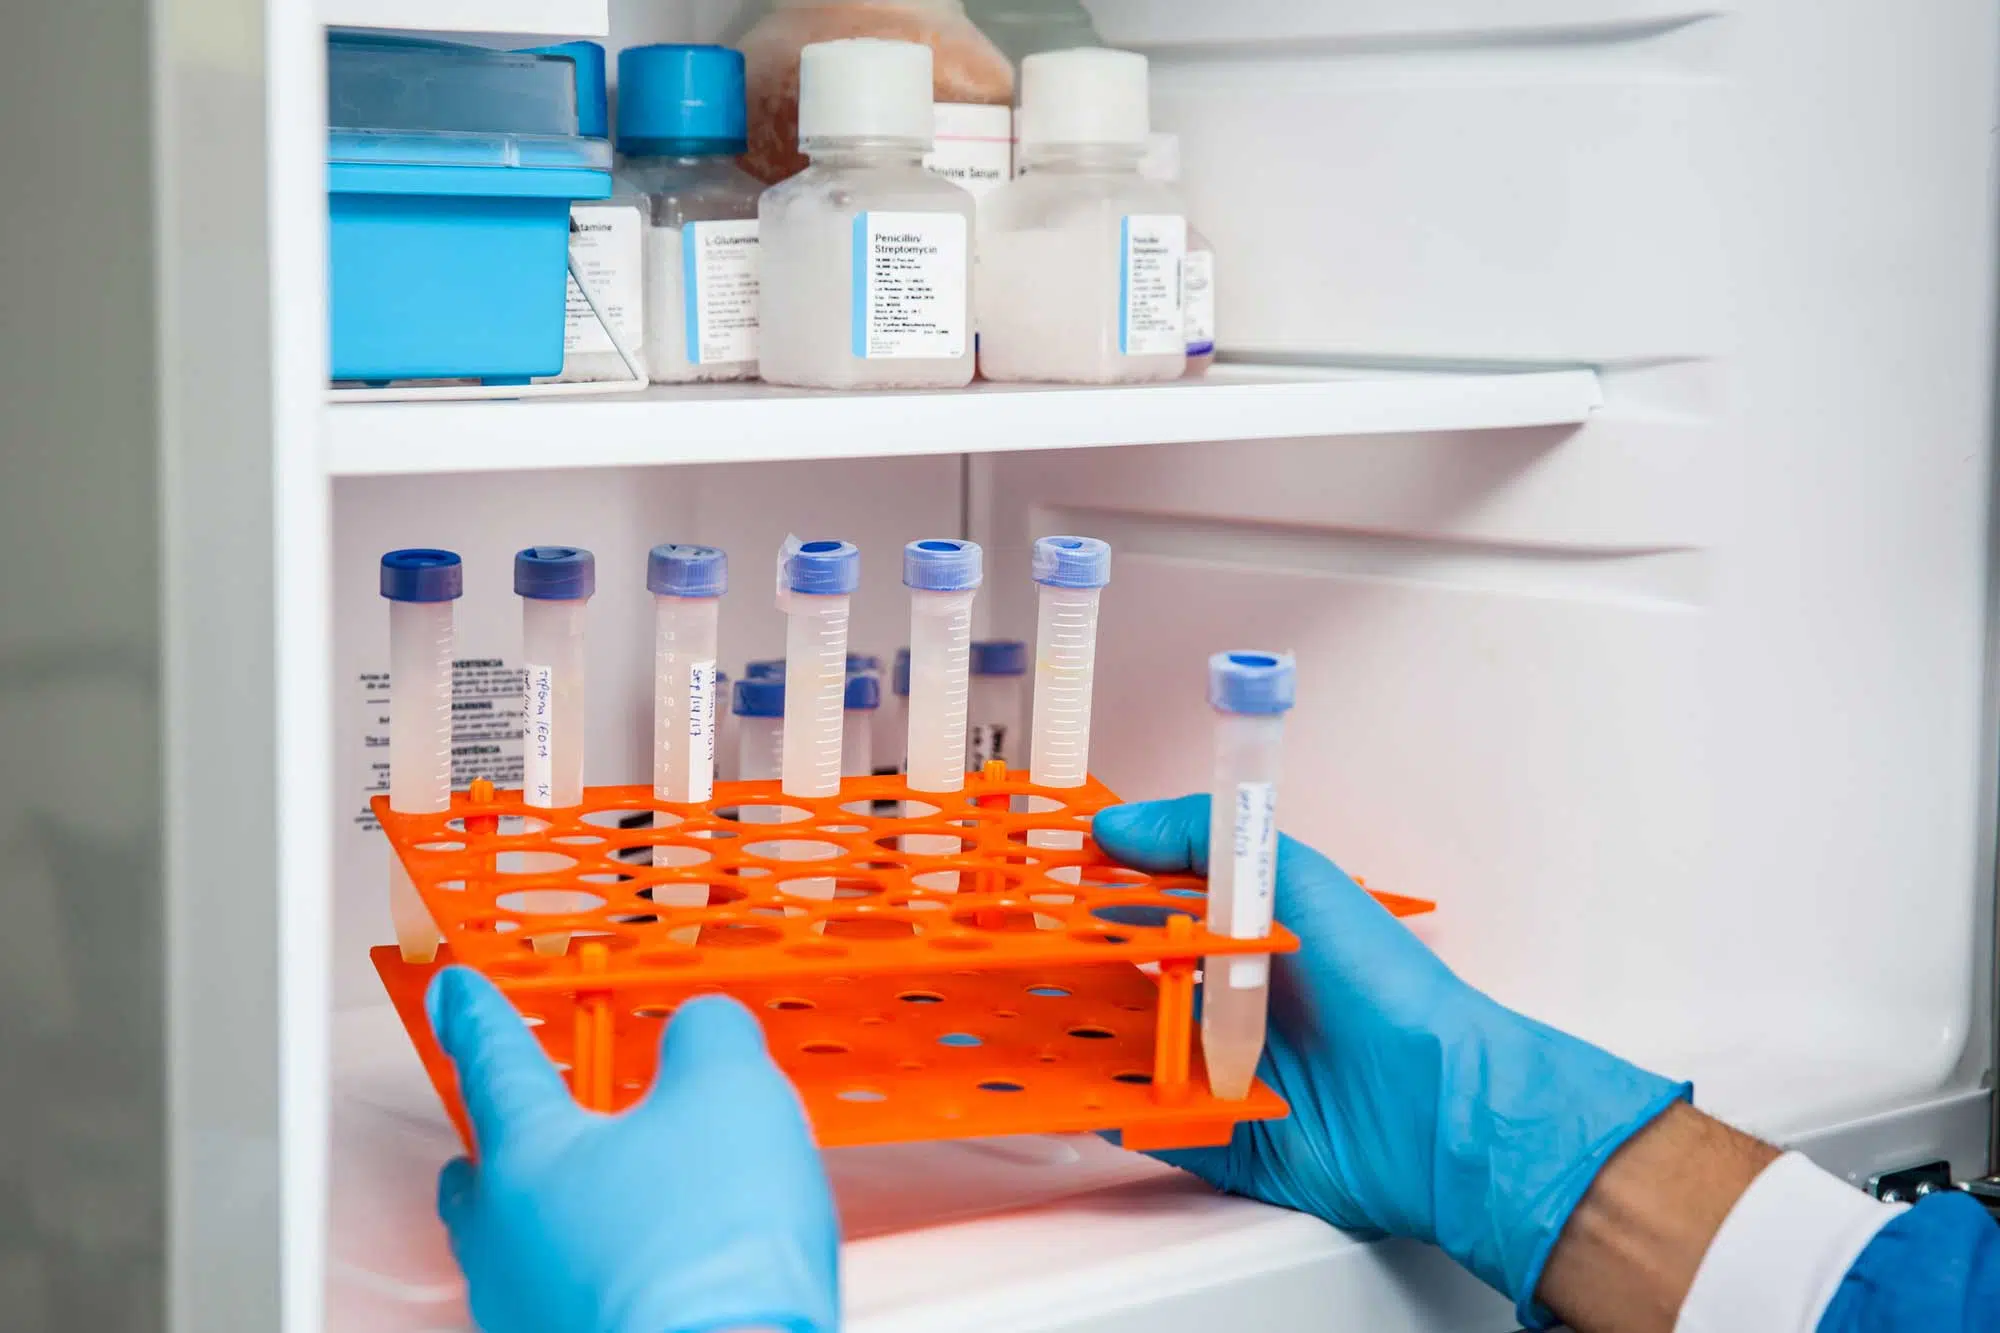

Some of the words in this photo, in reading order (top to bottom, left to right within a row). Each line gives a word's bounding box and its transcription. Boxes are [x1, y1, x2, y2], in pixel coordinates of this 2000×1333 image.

[576, 223, 613, 233] tamine
[874, 245, 938, 255] Streptomycin
[452, 659, 503, 668] VERTENCIA
